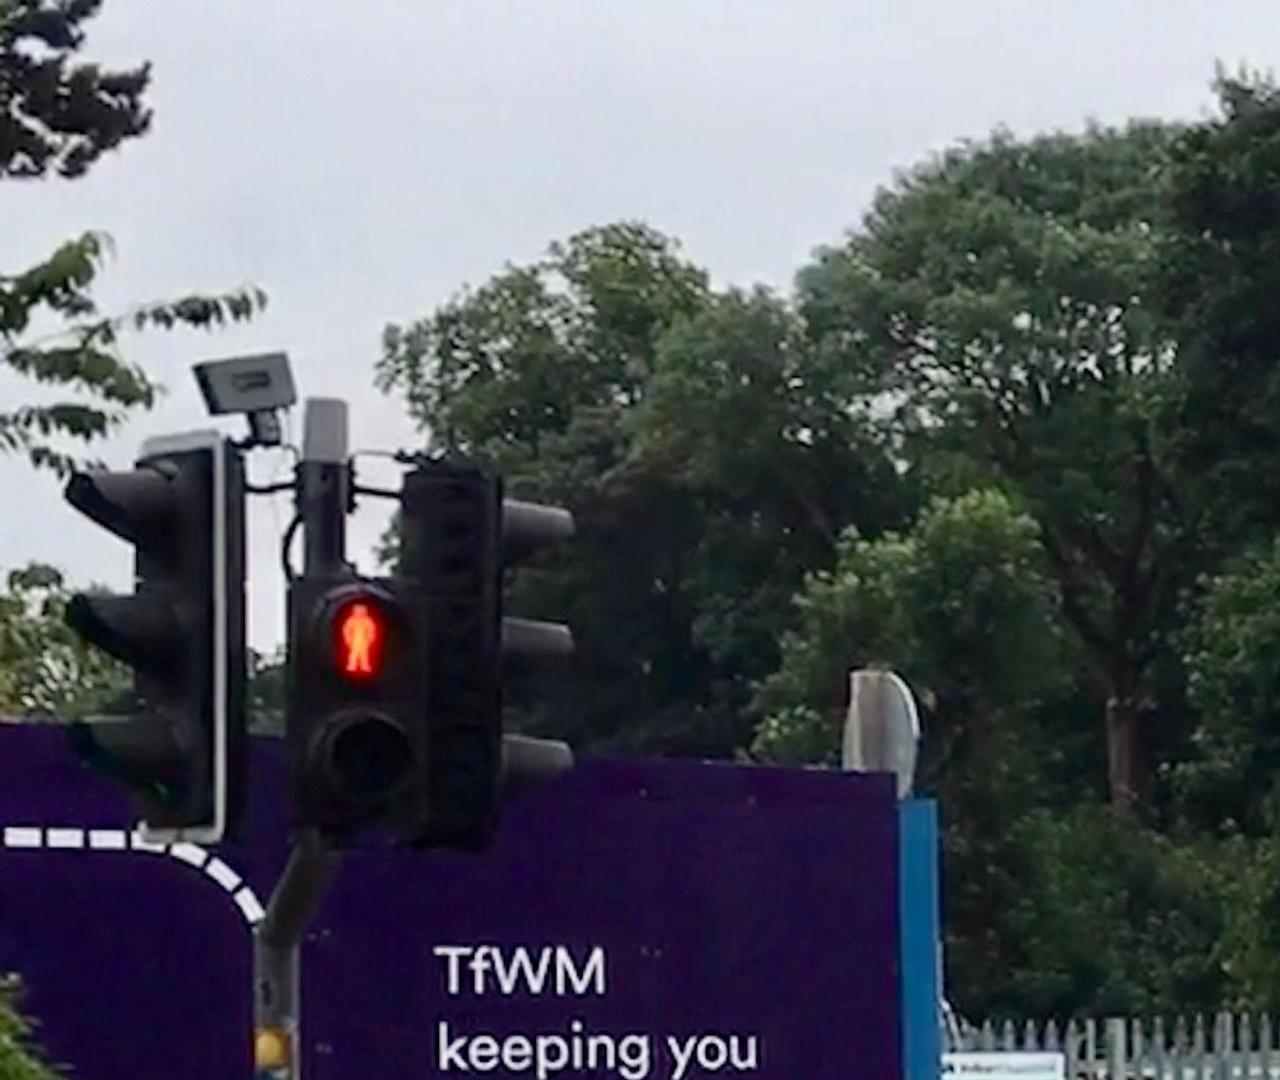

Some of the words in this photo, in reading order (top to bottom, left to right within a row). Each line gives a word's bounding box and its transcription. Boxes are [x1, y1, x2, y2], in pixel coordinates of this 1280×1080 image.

[433, 946, 605, 994] TfWM
[438, 1021, 651, 1080] keeping
[667, 1036, 757, 1080] you
